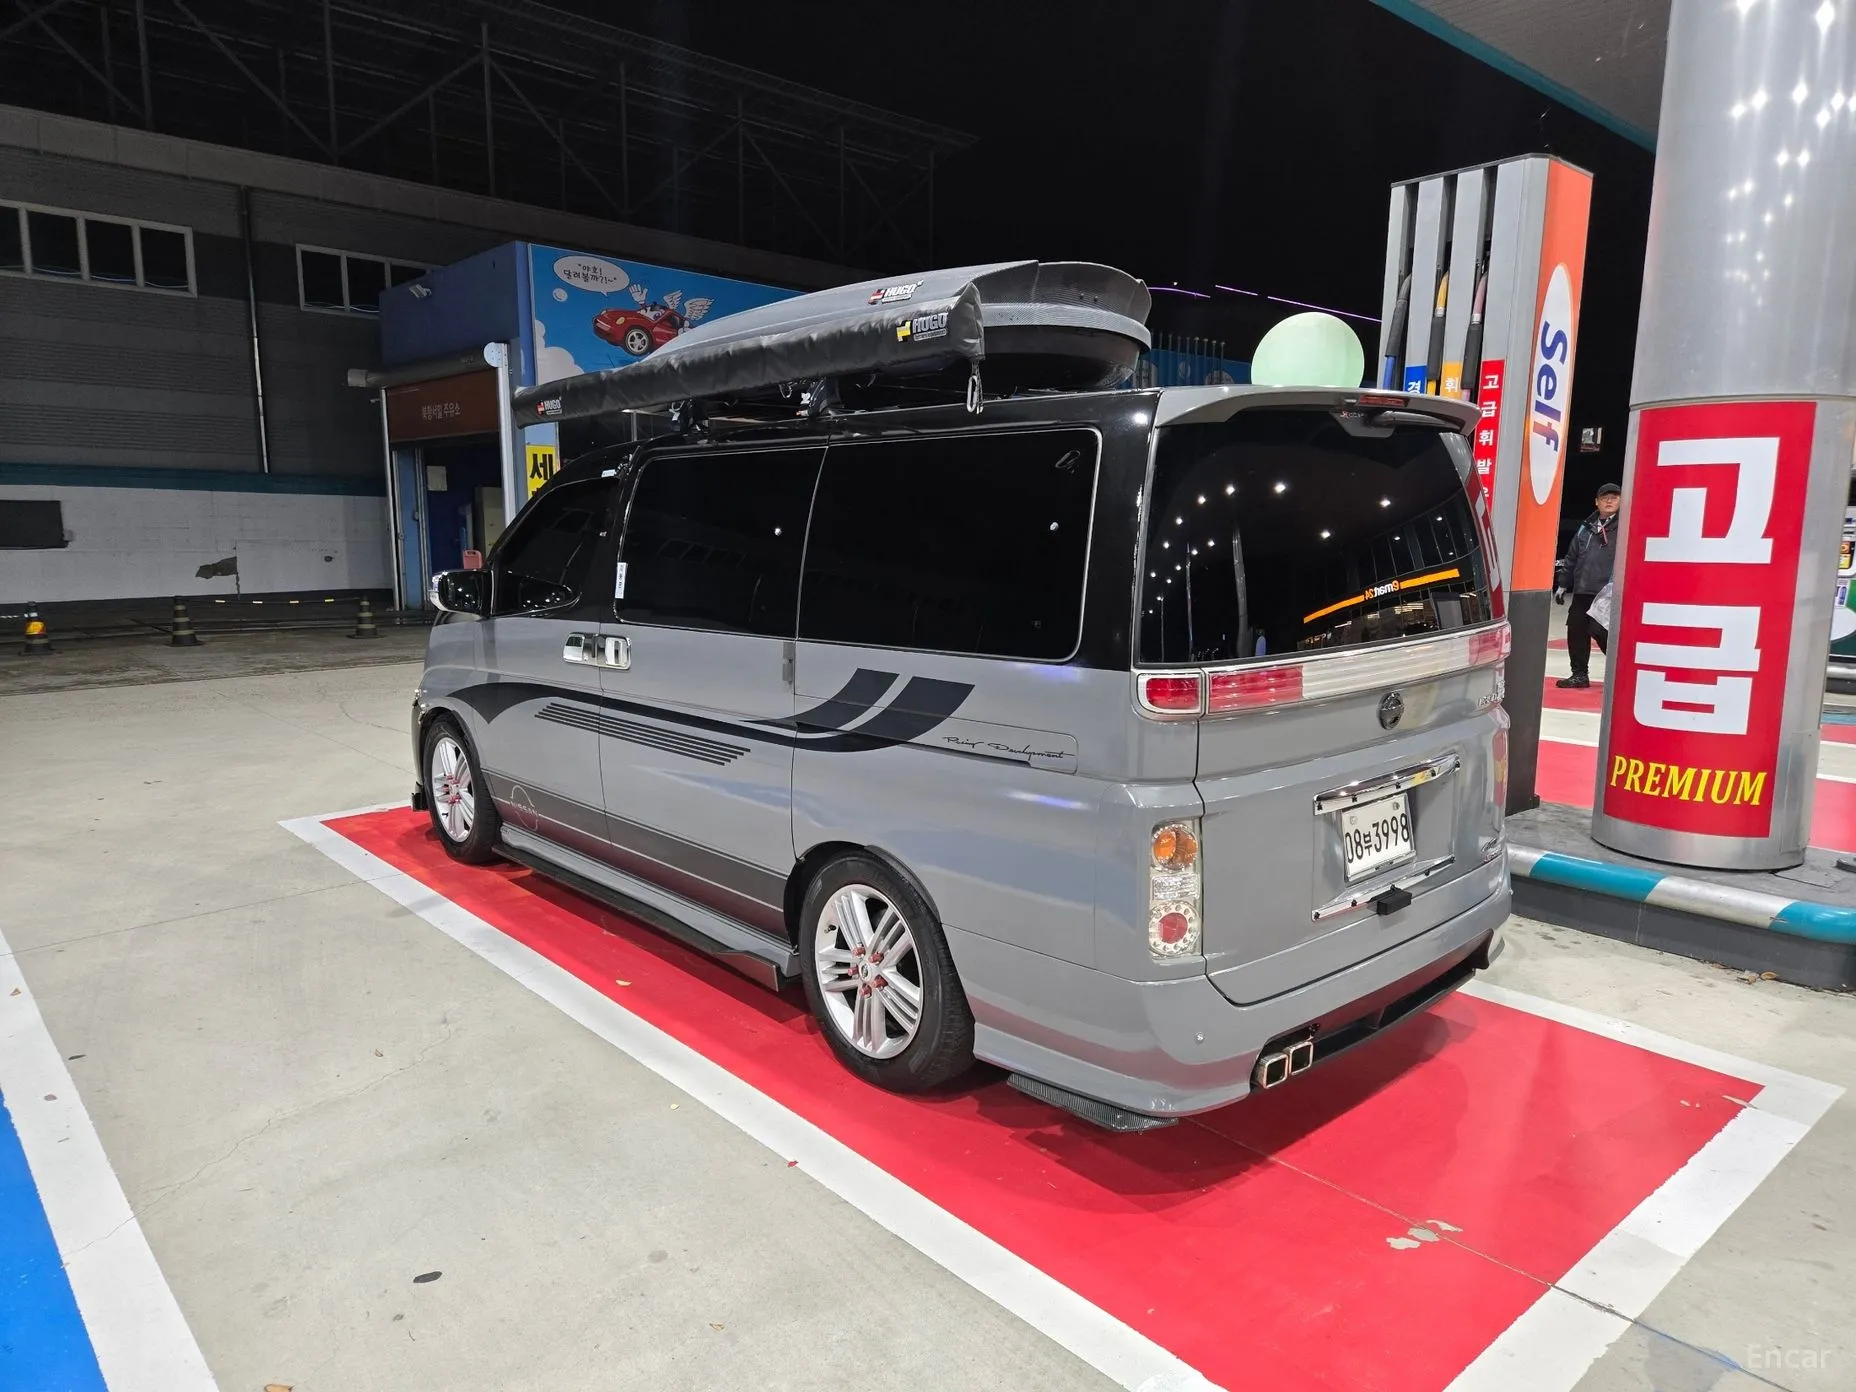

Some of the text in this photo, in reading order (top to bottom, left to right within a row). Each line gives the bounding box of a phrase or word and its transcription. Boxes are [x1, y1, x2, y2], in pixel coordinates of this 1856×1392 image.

[884, 282, 917, 298] HUGO
[912, 312, 949, 335] HUGO
[1532, 320, 1568, 452] Self
[1633, 436, 1780, 736] 고급
[1609, 755, 1768, 806] PREMIUM
[1344, 812, 1411, 865] 08부3998
